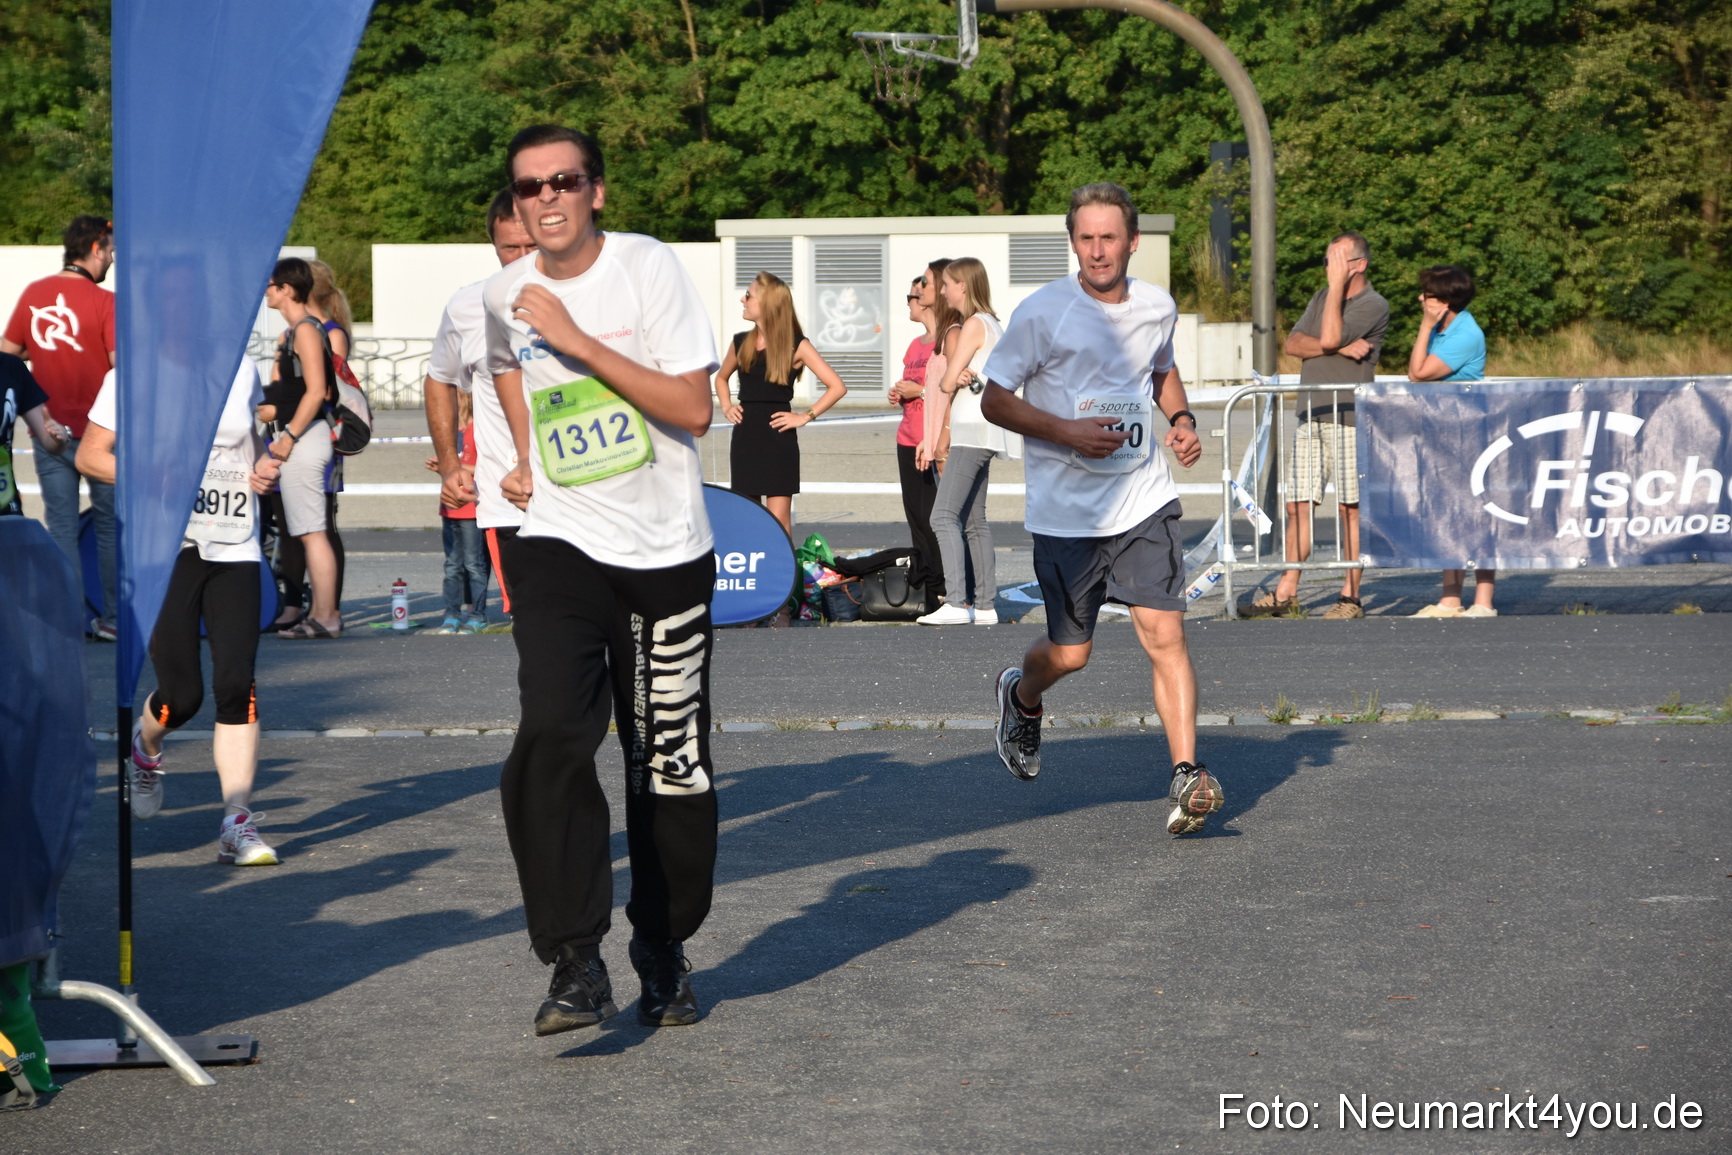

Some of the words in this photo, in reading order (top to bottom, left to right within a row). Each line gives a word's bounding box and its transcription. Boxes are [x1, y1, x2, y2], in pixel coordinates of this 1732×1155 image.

[593, 325, 633, 341] nergie
[1079, 399, 1142, 413] df-sports
[548, 412, 635, 459] 1312
[556, 463, 584, 474] Christian
[1531, 456, 1732, 508] Fisch
[193, 488, 247, 517] 8912
[713, 578, 756, 591] BILE
[630, 612, 647, 718] ESTABLISHED
[632, 718, 647, 760] SINCE
[16, 1051, 37, 1062] den
